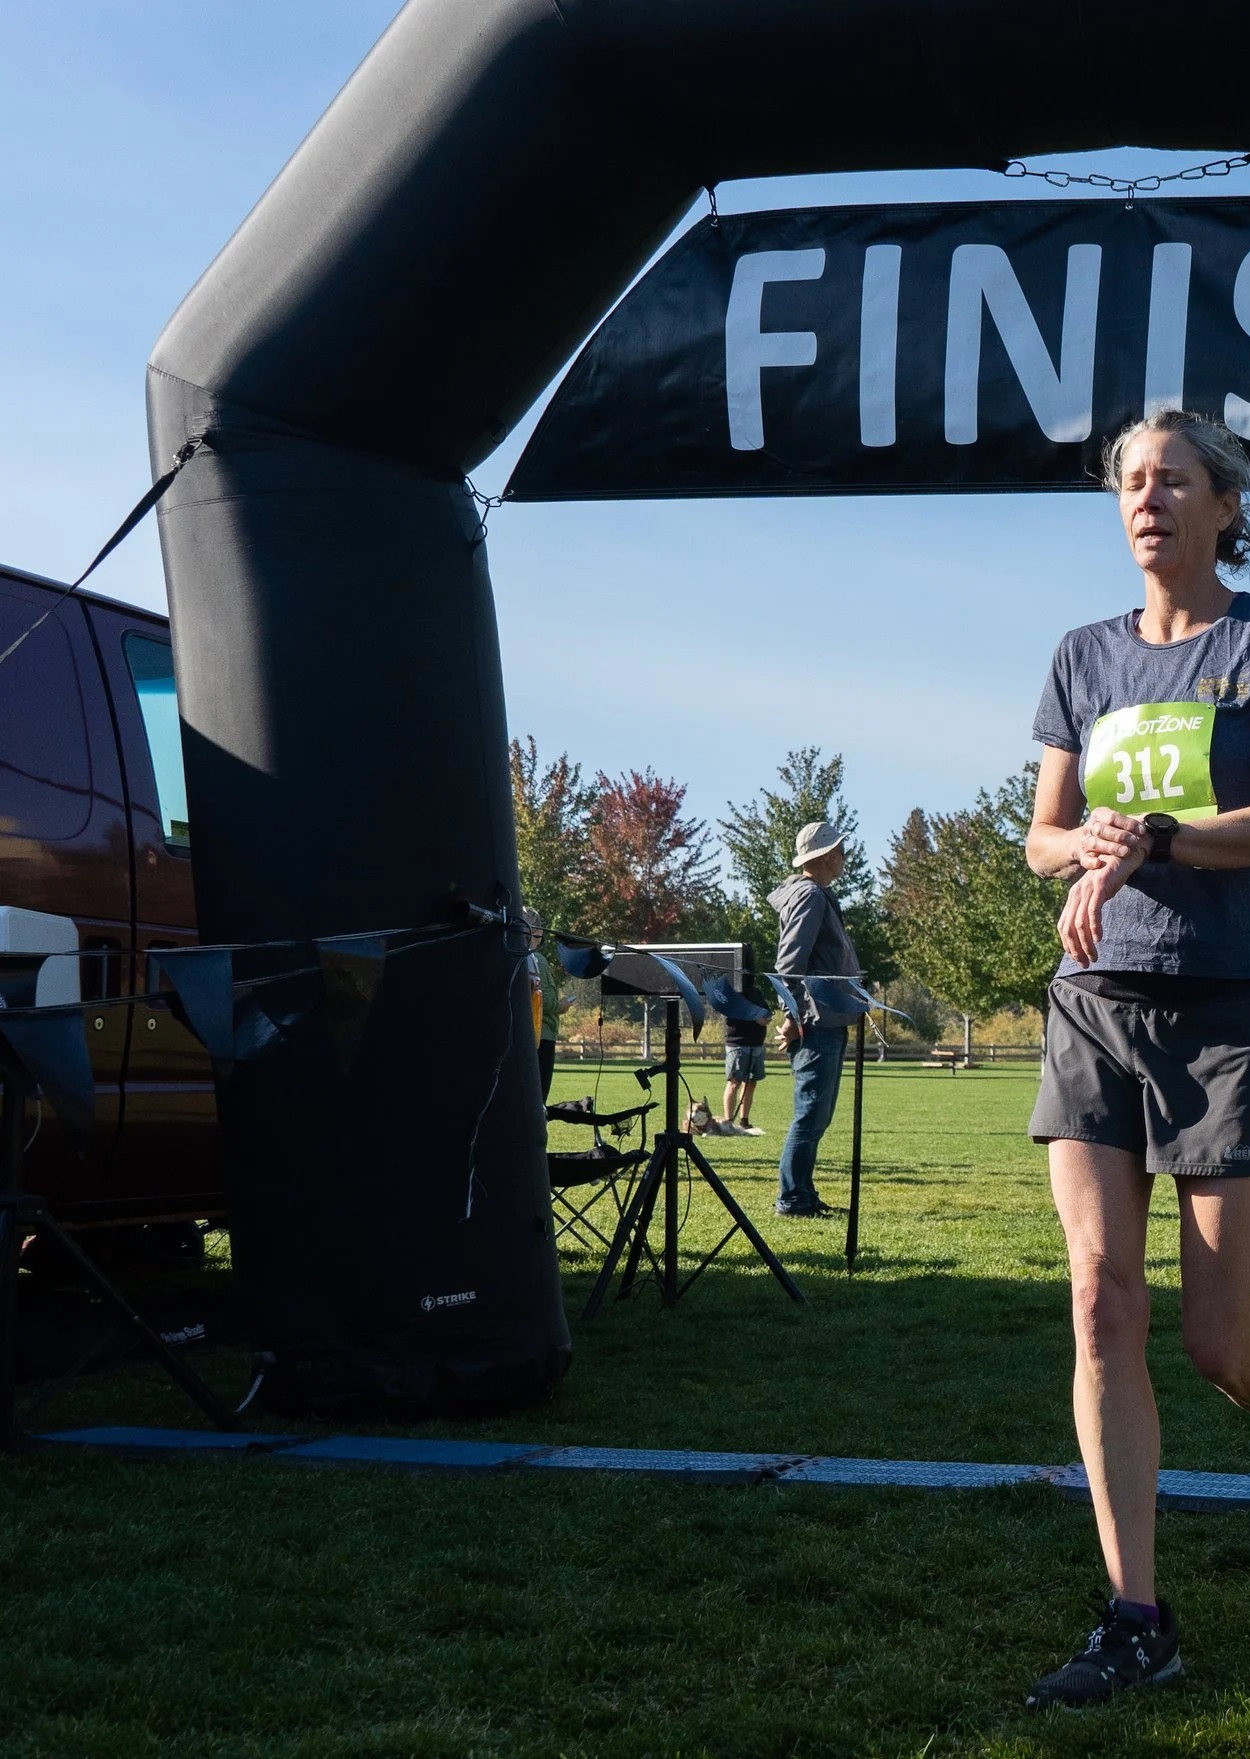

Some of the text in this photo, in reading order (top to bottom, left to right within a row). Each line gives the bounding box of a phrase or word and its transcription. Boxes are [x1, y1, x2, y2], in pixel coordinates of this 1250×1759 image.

[1112, 715, 1204, 738] OTZONE
[1112, 744, 1185, 804] 312
[1234, 1149, 1250, 1157] REI
[436, 1291, 477, 1306] STRIKE
